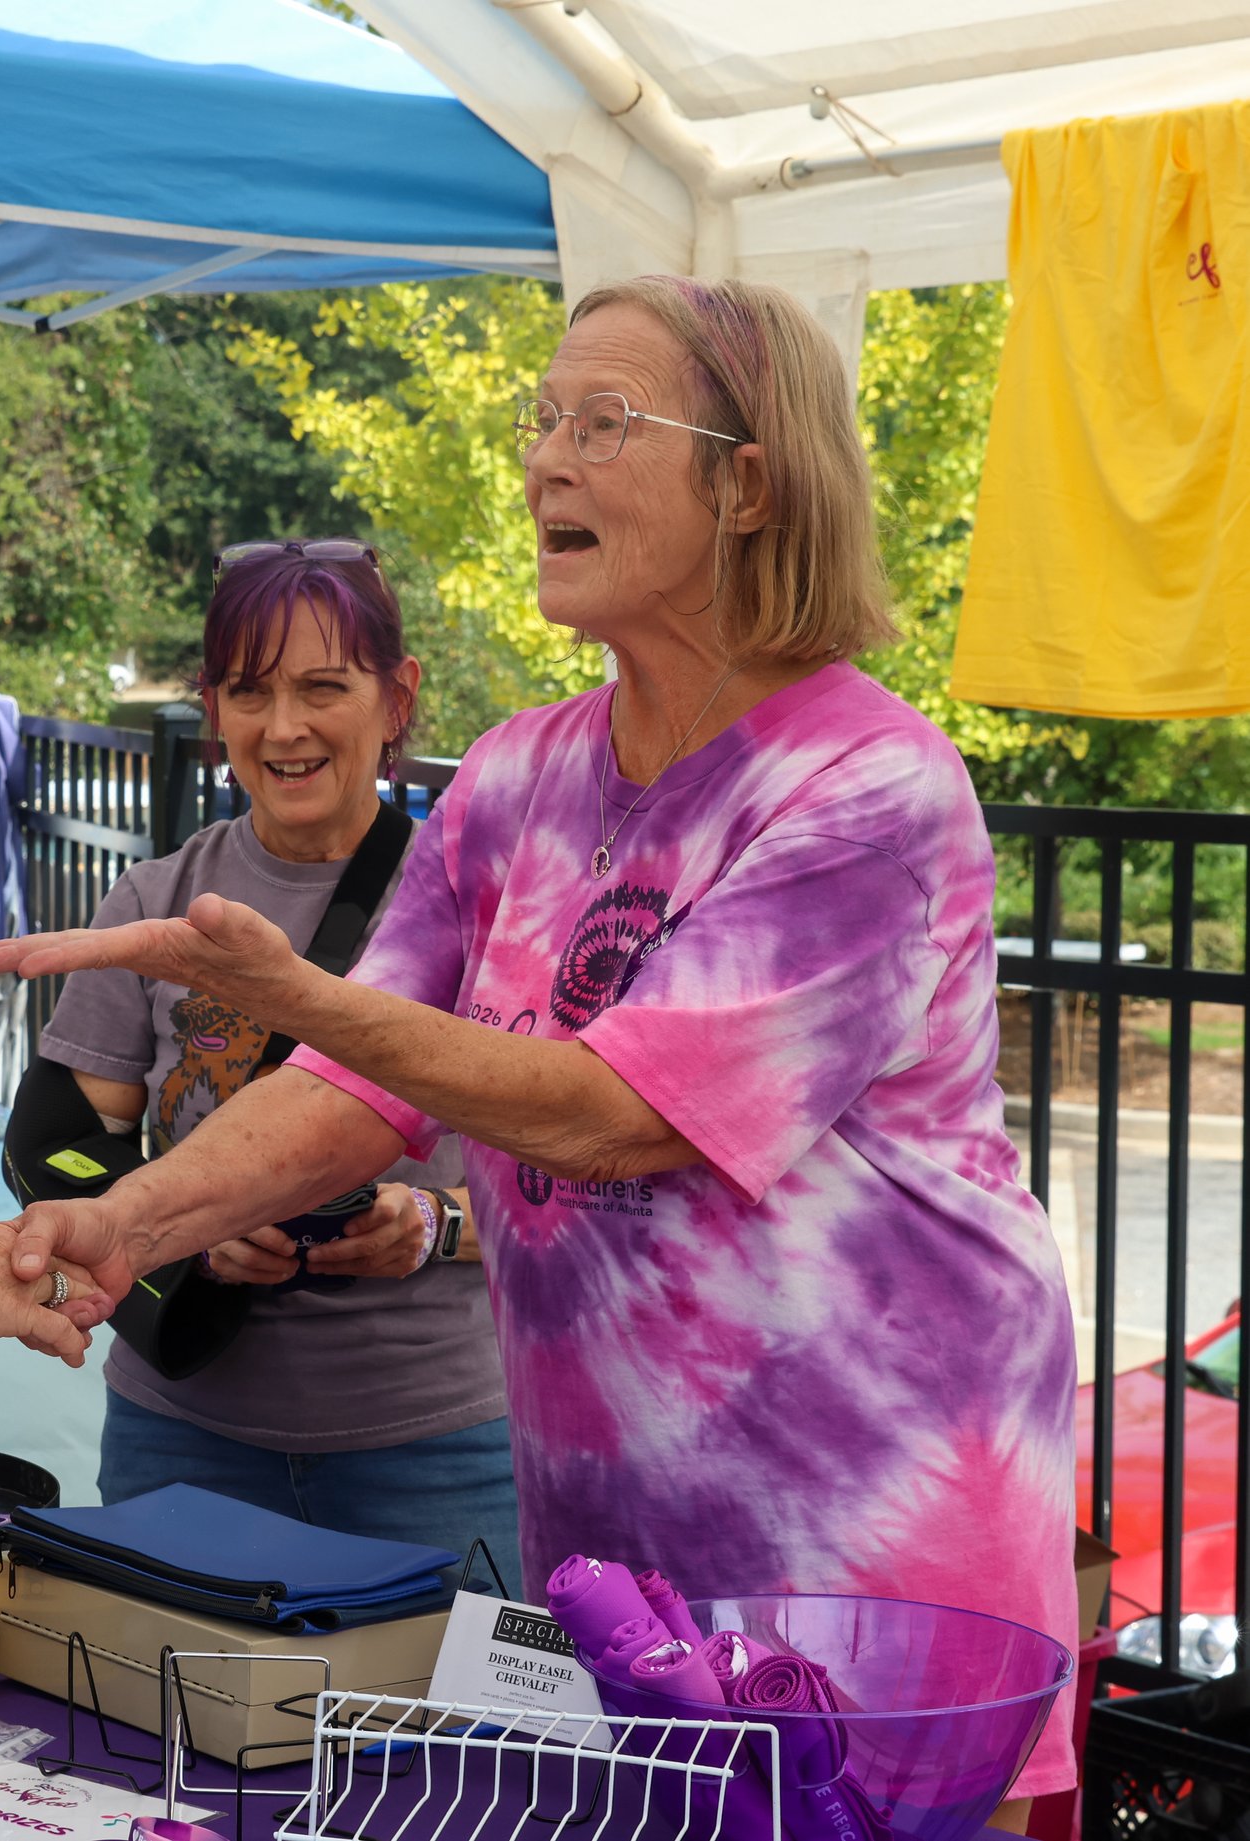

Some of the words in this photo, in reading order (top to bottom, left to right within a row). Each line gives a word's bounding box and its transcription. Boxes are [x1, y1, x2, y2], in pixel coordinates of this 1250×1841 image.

[602, 1200, 615, 1213] of
[617, 1202, 653, 1218] Alanta
[511, 1634, 564, 1651] moments
[488, 1652, 537, 1675] DISPLAY
[538, 1664, 575, 1682] EASEL
[495, 1671, 559, 1695] CHEVALET
